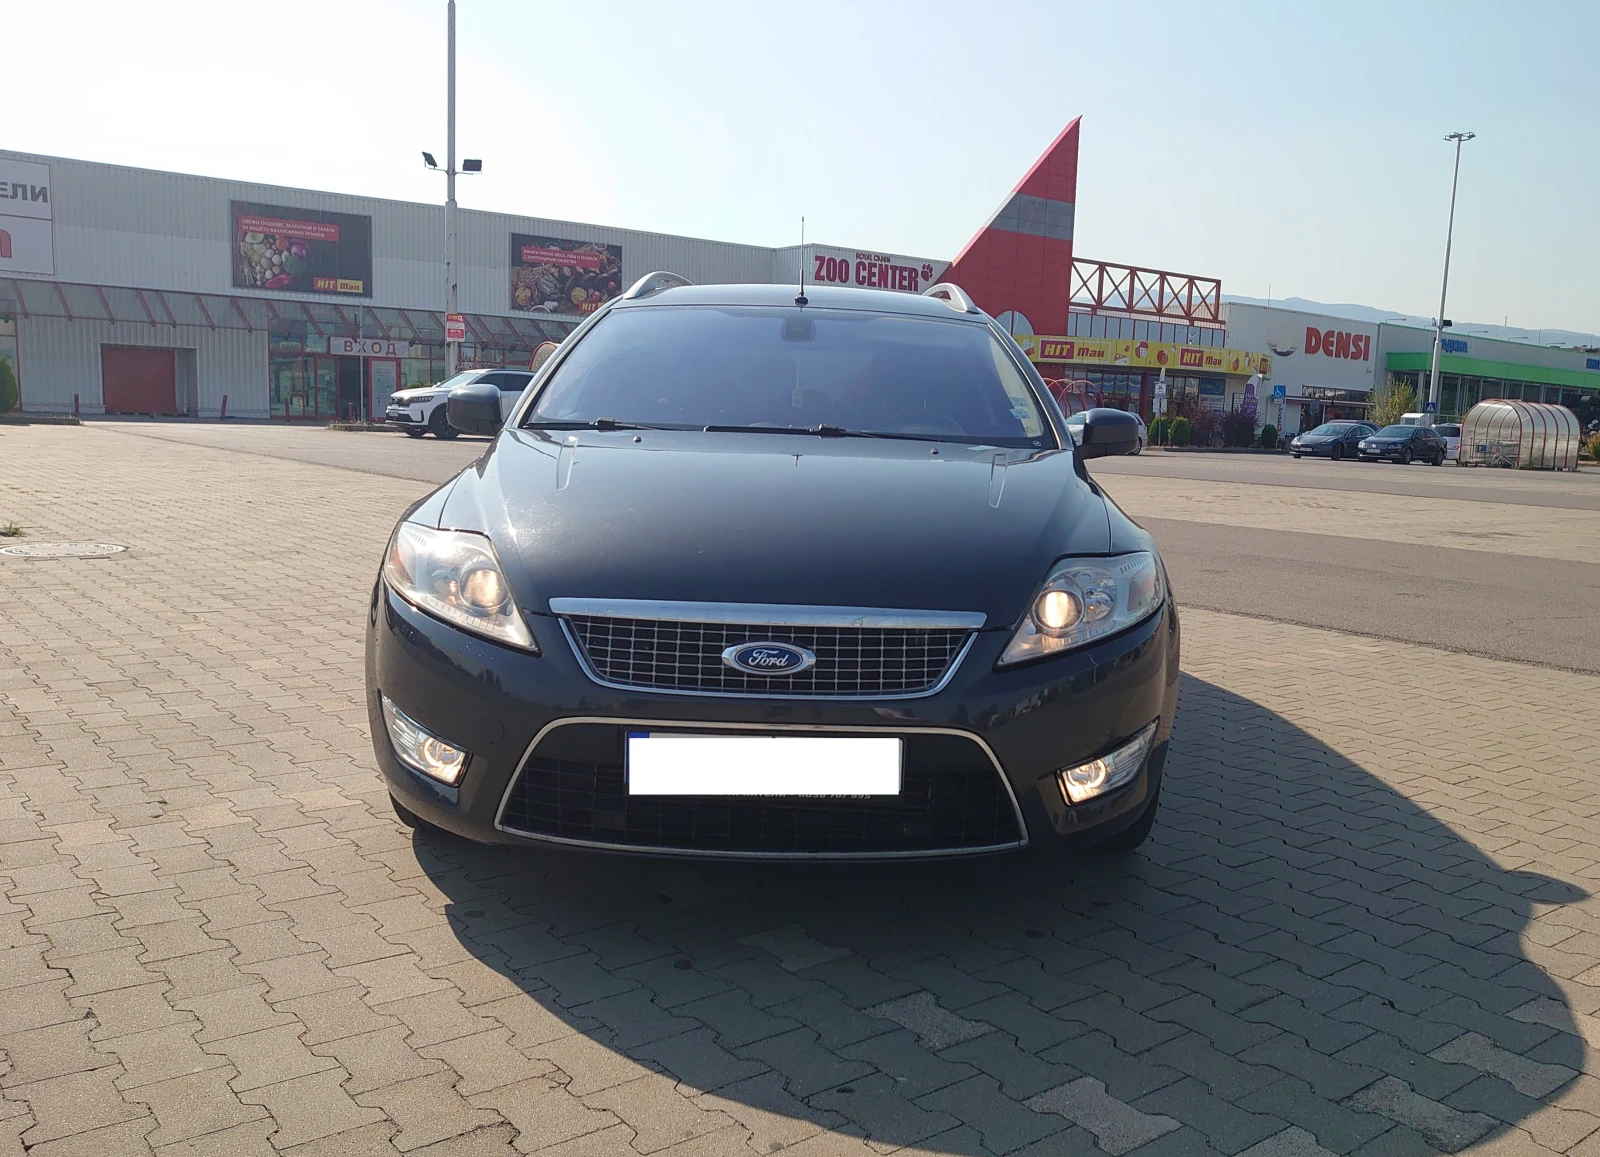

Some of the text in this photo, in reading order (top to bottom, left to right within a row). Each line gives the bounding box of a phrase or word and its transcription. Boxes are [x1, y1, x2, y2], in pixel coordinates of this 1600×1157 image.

[855, 252, 873, 261] ROYAL
[814, 255, 919, 292] ZOO CENTER
[317, 279, 335, 289] HIT
[581, 302, 597, 311] HIT
[344, 340, 397, 356] ВХОД
[1044, 343, 1071, 356] HIT
[1304, 326, 1371, 362] DENSI
[1182, 351, 1202, 364] HIT
[748, 648, 790, 667] Ford
